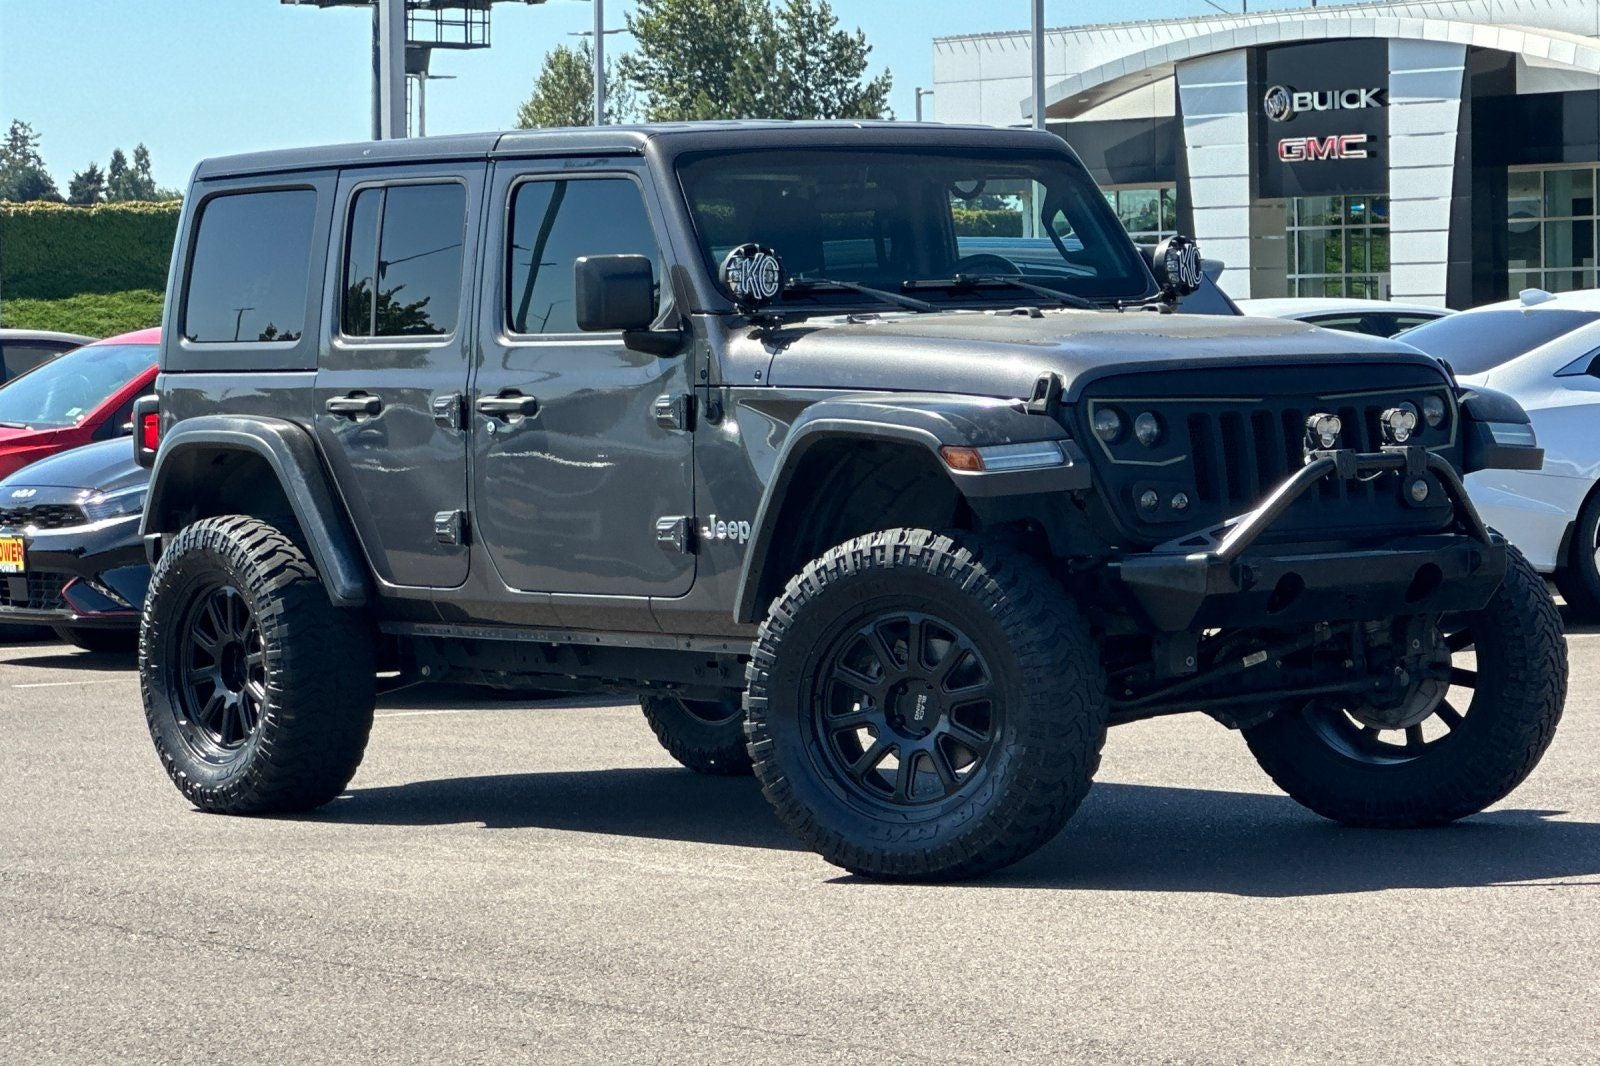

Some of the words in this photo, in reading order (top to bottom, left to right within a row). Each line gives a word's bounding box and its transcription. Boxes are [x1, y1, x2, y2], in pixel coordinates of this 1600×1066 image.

[1293, 88, 1382, 112] BUICK
[1278, 134, 1367, 162] GMC
[741, 252, 779, 300] KC
[1180, 243, 1203, 288] KC
[702, 514, 751, 544] Jeep
